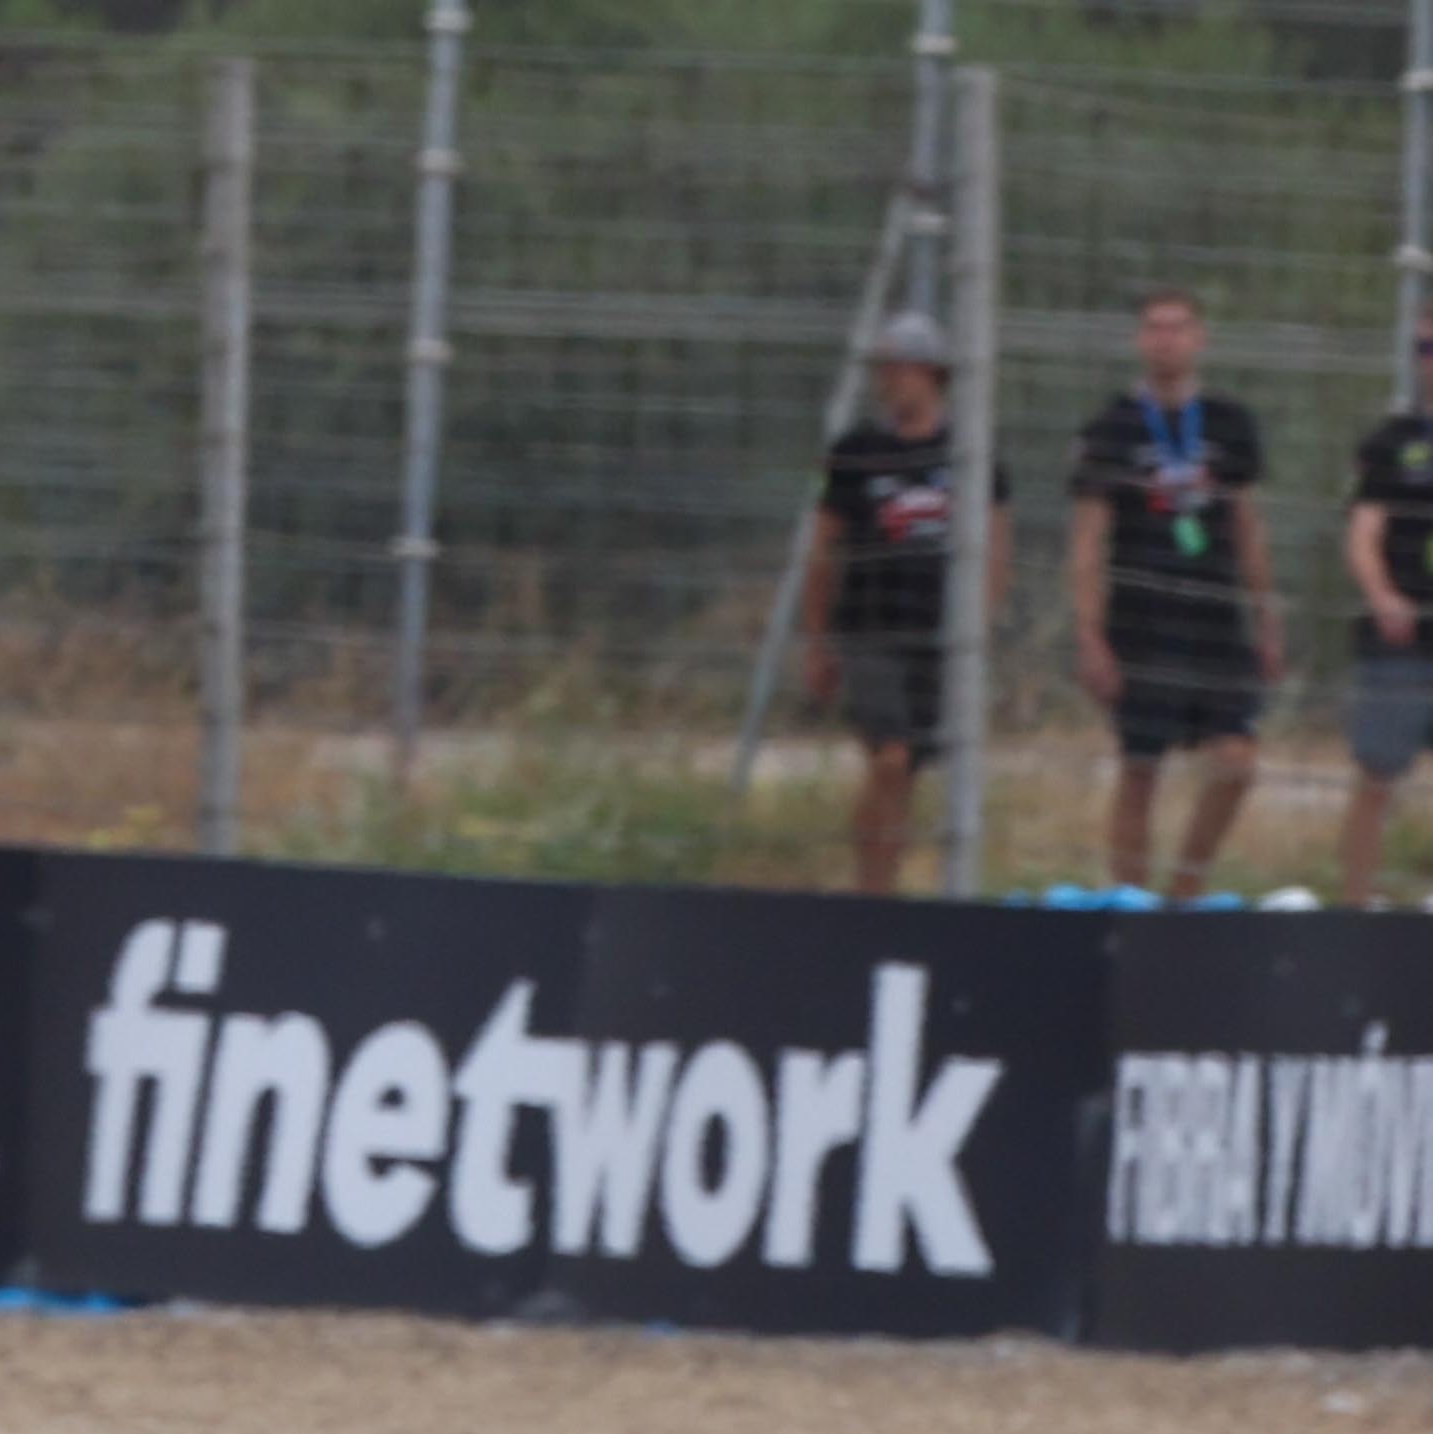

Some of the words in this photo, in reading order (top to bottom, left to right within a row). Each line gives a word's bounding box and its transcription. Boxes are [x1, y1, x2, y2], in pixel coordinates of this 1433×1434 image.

[84, 919, 1002, 1276] finetwork
[1106, 1050, 1263, 1247] FIBRA
[1262, 1053, 1313, 1247] Y
